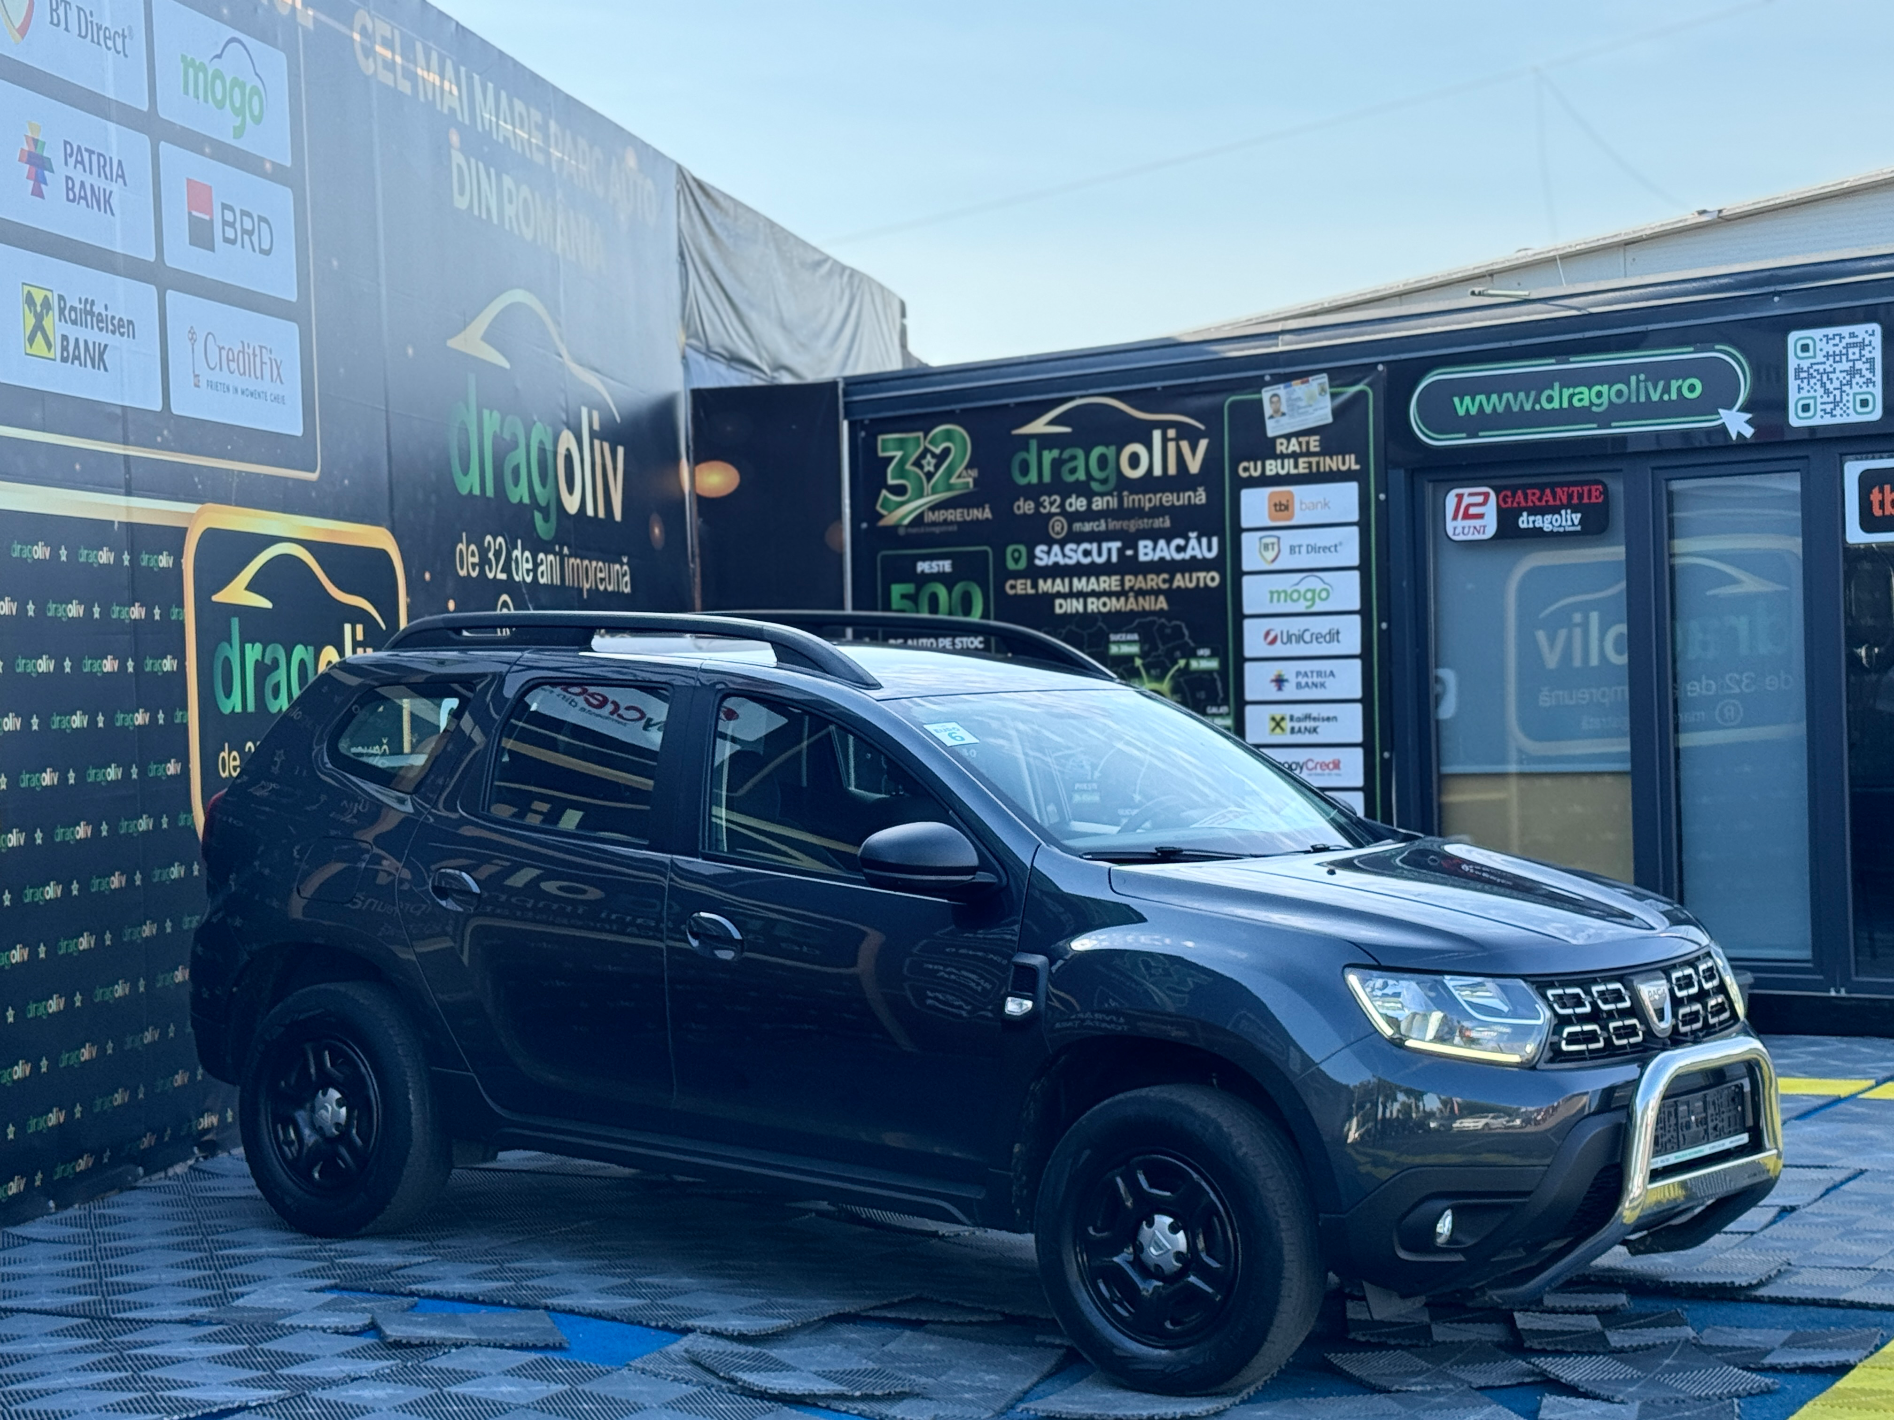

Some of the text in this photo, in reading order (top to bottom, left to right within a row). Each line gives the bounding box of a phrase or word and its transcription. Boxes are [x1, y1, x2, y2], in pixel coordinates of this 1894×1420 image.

[49, 0, 72, 33] BT
[181, 53, 265, 139] mogo
[353, 9, 412, 96] CEL
[415, 40, 470, 125] MAI
[472, 72, 545, 166] MARE
[63, 139, 127, 187] PATRIA
[65, 175, 115, 217] BANK
[450, 148, 498, 225] DIN
[221, 202, 273, 257] BRD
[57, 293, 135, 340] Raiffeisen
[60, 334, 108, 373] BANK
[204, 331, 284, 385] CreditFix
[1453, 373, 1703, 417] www.dragoliv.ro
[450, 372, 624, 541] dragoliv
[1276, 436, 1320, 454] RATE
[876, 424, 972, 516] 32
[1011, 428, 1209, 493] dragoliv
[1238, 454, 1360, 477] CU BULETINUL
[1013, 486, 1207, 515] de 32 de ani împreună
[1273, 498, 1331, 512] tbi bank
[1452, 485, 1604, 521] 12 GARANTIE
[1072, 518, 1106, 533] marcă
[1453, 525, 1487, 536] LUNI
[1518, 509, 1581, 532] dragoliv
[11, 540, 174, 571] dragoliv dragoliv dragoliv
[1034, 541, 1122, 567] SASCUT
[1137, 531, 1219, 562] BACĂU
[1289, 545, 1303, 556] BT
[456, 532, 631, 600] de 32 de ani împreună
[916, 560, 953, 574] PESTE
[1005, 571, 1220, 595] CEL MAI MARE PARC AUTO
[46, 599, 84, 621] dragoliv
[110, 601, 146, 623] dragoliv
[1054, 592, 1169, 614] DIN ROMÂNIA
[1269, 587, 1330, 610] mogo
[954, 636, 985, 650] STOC
[1280, 628, 1340, 645] UniCredit
[15, 654, 178, 677] dragoliv dragoliv dragoliv
[1296, 670, 1335, 680] PATRIA
[1296, 681, 1327, 690] BANK
[51, 710, 89, 733] dragoliv
[114, 708, 150, 730] dragoliv
[1289, 714, 1337, 724] Raiffeisen
[1289, 725, 1320, 735] BANK
[948, 732, 965, 742] 6
[218, 742, 241, 779] de
[19, 758, 182, 791] dragoliv dragoliv dragoliv
[54, 821, 92, 844] dragoliv
[118, 814, 154, 837] dragoliv
[22, 881, 62, 905] dragoliv
[90, 871, 127, 894] dragoliv
[57, 932, 96, 956] dragoliv
[26, 994, 66, 1019] dragoliv
[59, 1043, 97, 1068] dragoliv
[26, 1107, 66, 1134] dragoliv
